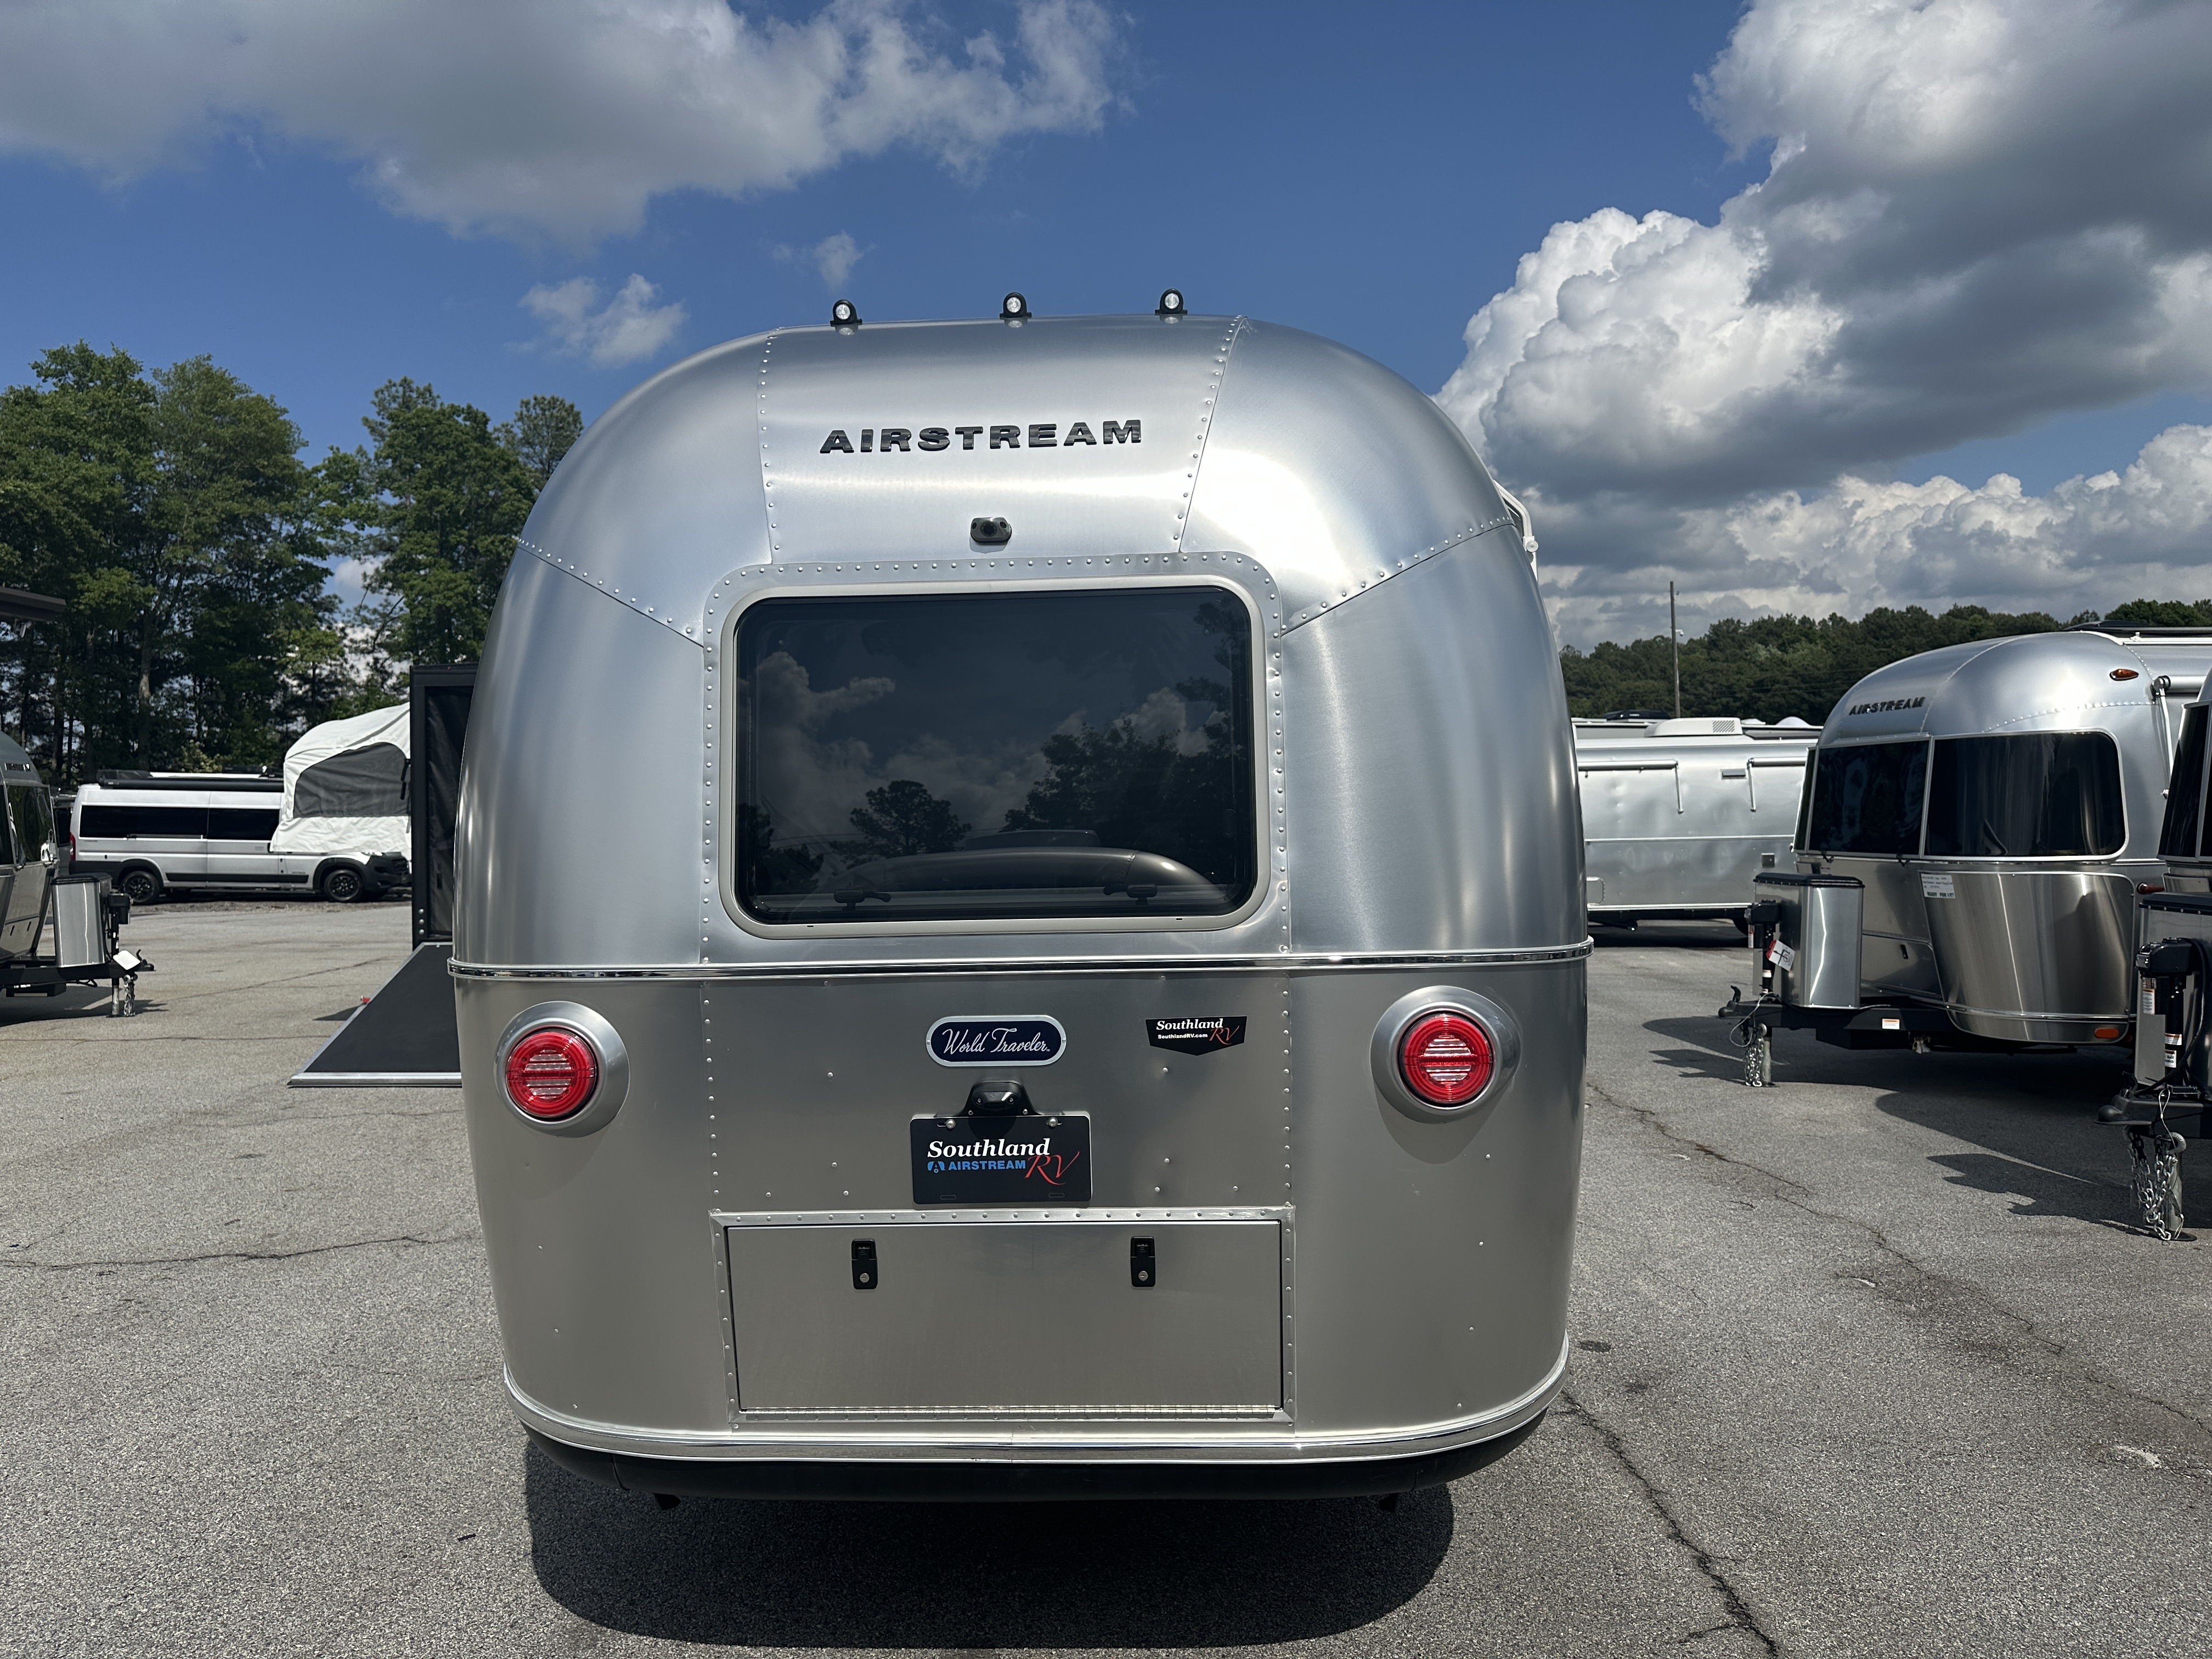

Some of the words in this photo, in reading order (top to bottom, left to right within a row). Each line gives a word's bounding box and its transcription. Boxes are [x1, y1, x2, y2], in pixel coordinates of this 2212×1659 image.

[820, 420, 1141, 453] AIRSTREAM
[1849, 697, 1926, 715] AIRSTREAM
[942, 1029, 990, 1055] World
[990, 1028, 1047, 1053] Traveler
[1156, 1018, 1223, 1030] Southland
[1209, 1025, 1240, 1045] RV
[927, 1138, 1050, 1158] Southland
[1024, 1151, 1080, 1186] RV
[948, 1160, 1026, 1170] AIRSTREAM
